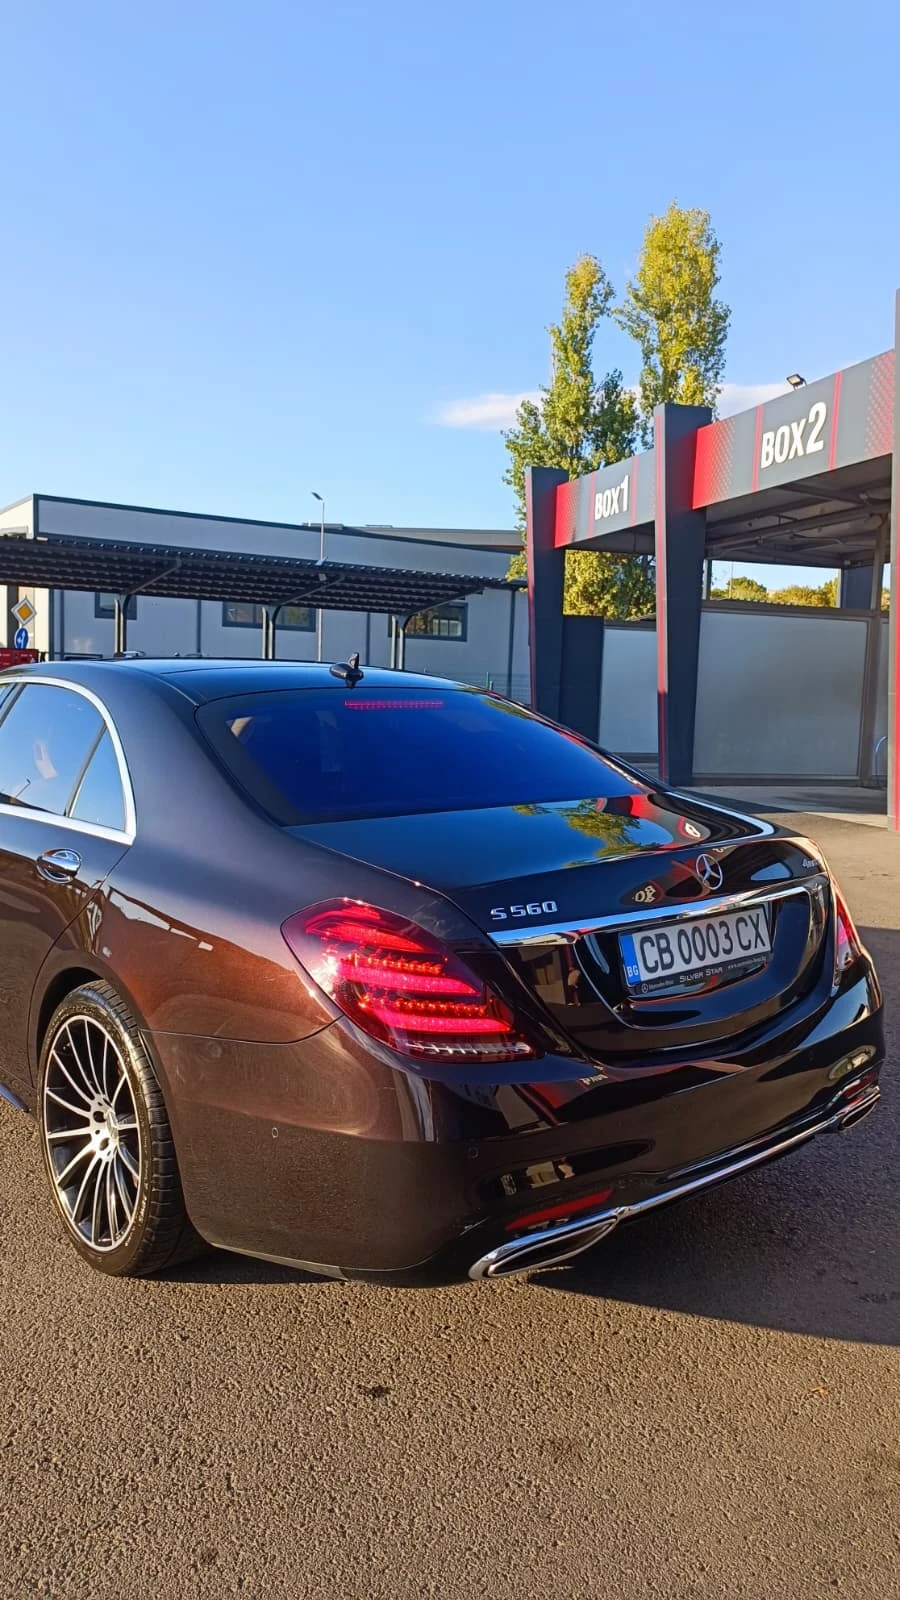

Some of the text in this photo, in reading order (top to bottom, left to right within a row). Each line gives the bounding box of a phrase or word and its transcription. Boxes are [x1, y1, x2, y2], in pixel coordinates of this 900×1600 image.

[490, 900, 558, 920] S 560
[639, 913, 766, 974] CB 0003 CX
[627, 964, 639, 977] BG
